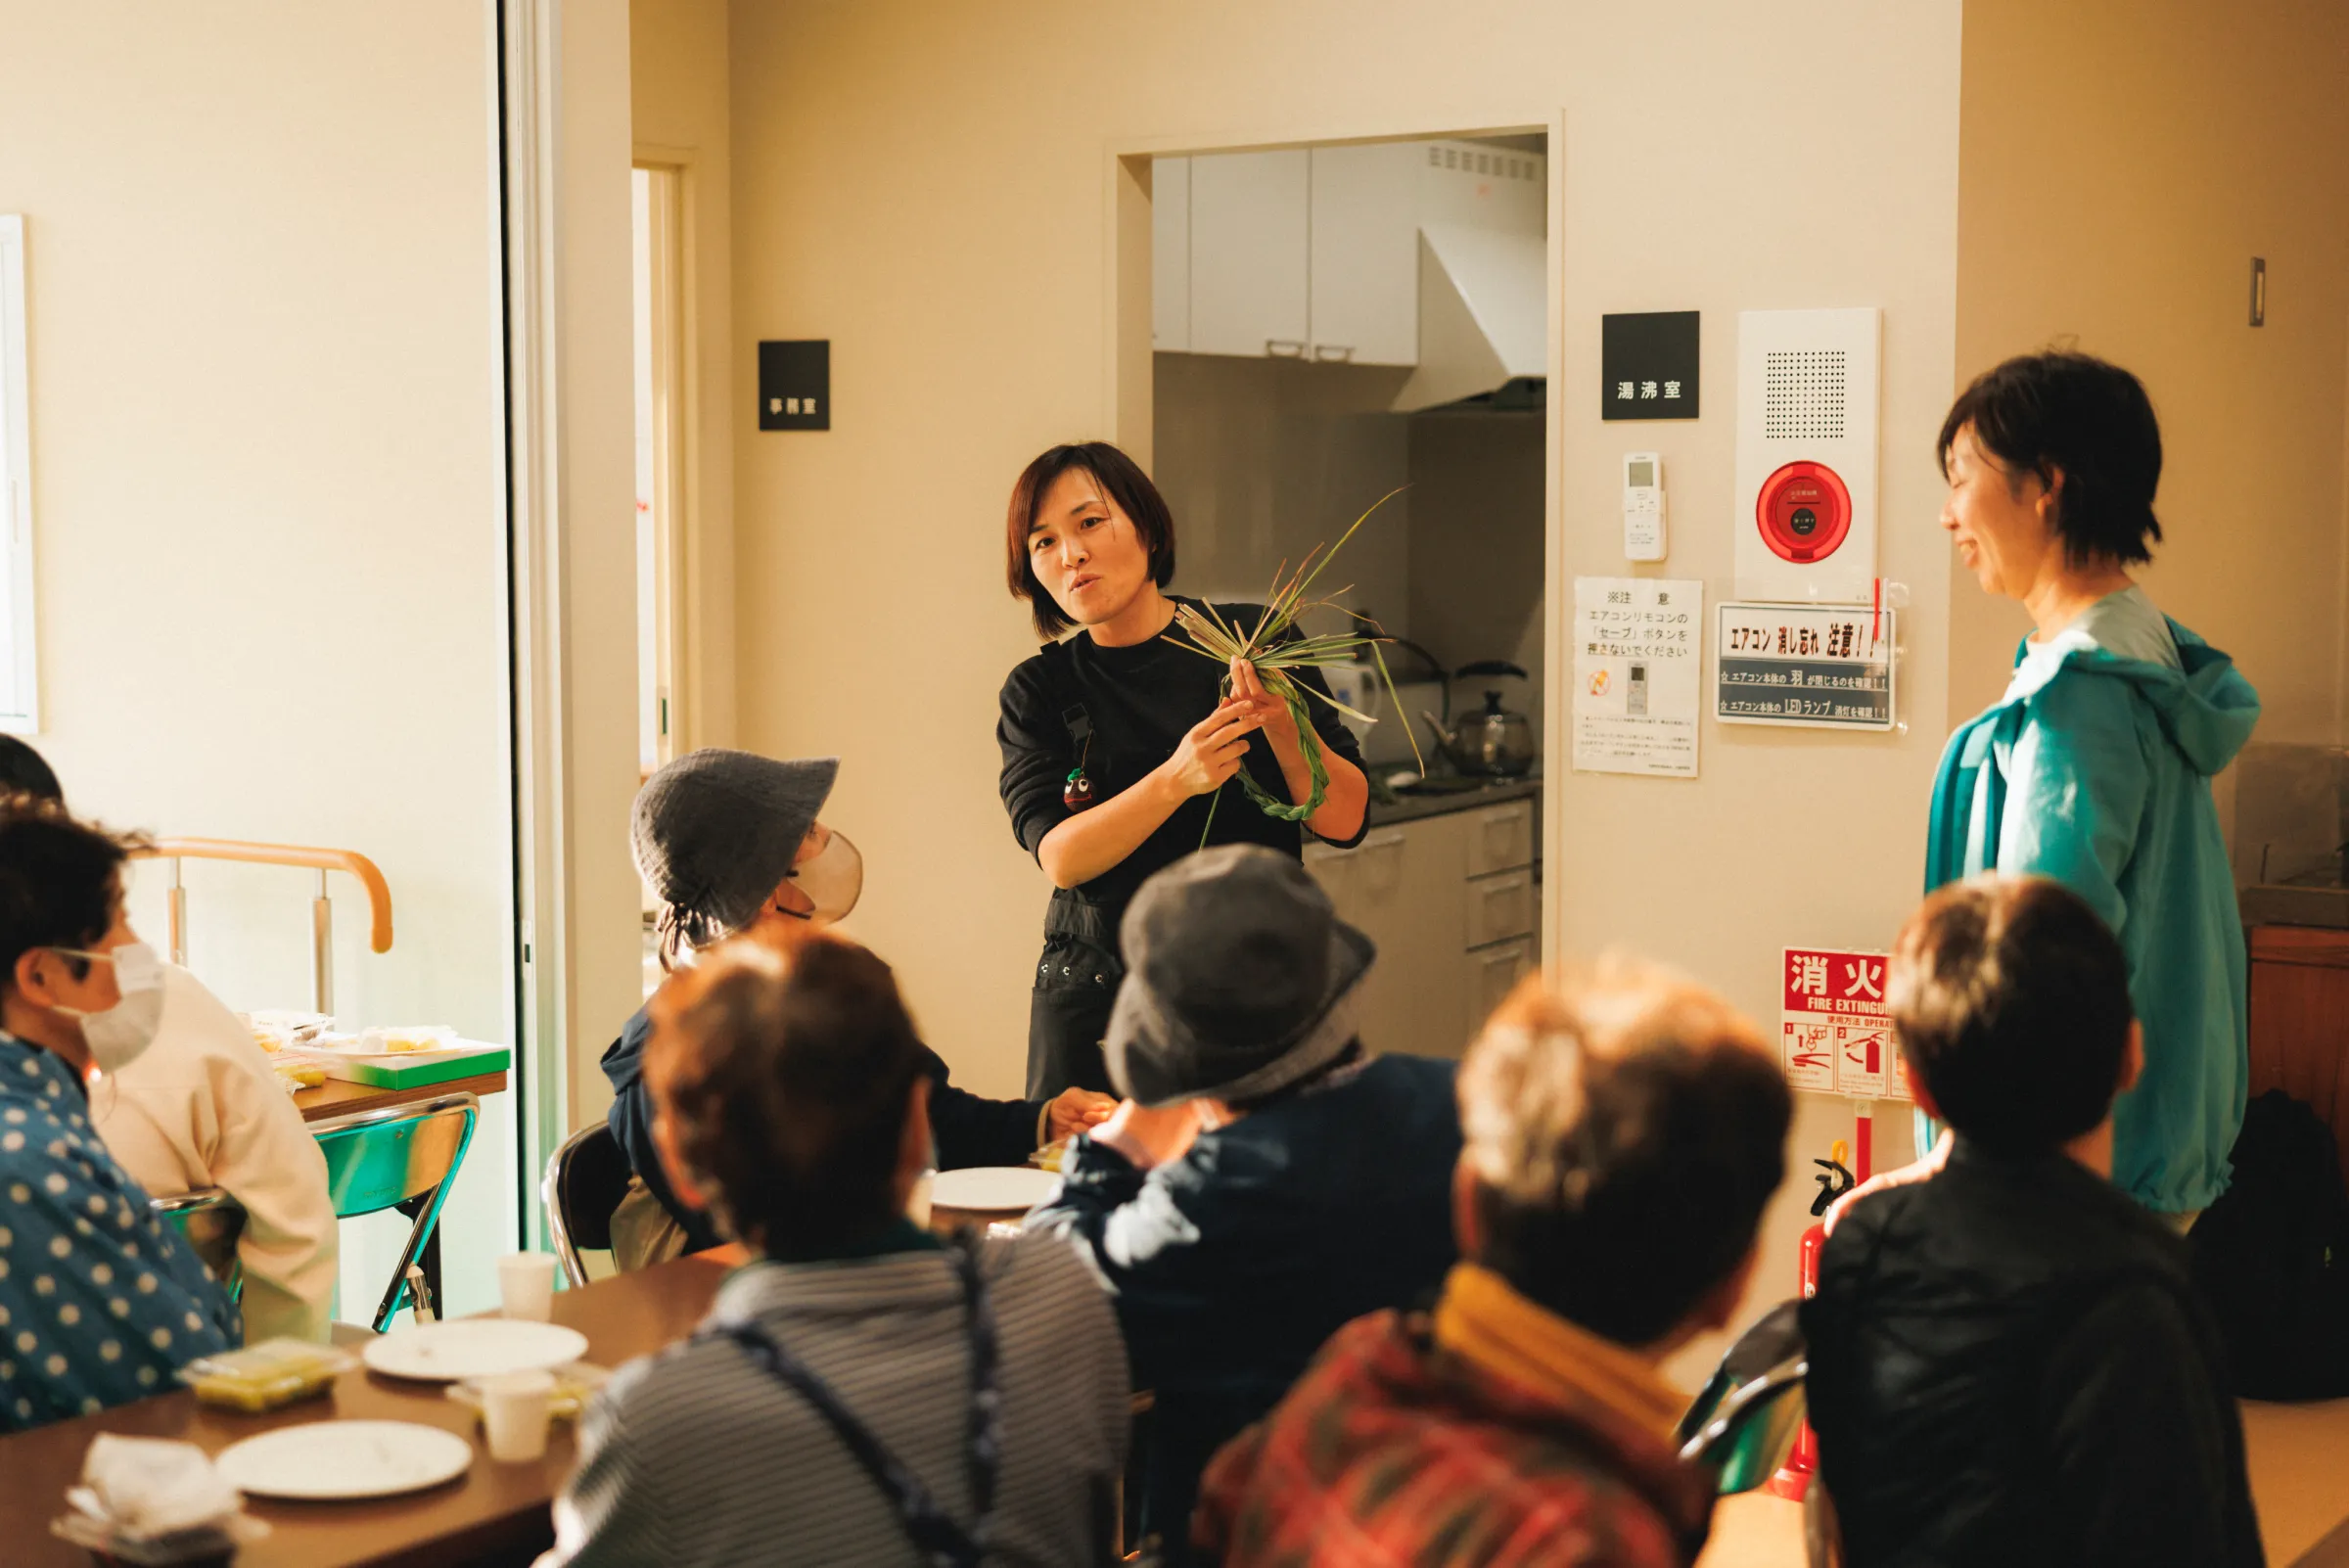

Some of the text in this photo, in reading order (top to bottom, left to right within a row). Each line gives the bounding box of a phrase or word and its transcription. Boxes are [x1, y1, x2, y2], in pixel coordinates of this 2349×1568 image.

[1618, 380, 1681, 399] 湯沸室
[1589, 611, 1687, 623] エアコンリモコンの
[1731, 627, 1771, 652] エアコン
[1777, 626, 1819, 655] 消し忘れ
[1588, 643, 1687, 658] 押さないでください
[1790, 669, 1803, 685] 羽
[1808, 996, 1892, 1015] FIRE EXTINGUI
[1865, 1018, 1895, 1029] OPERAT
